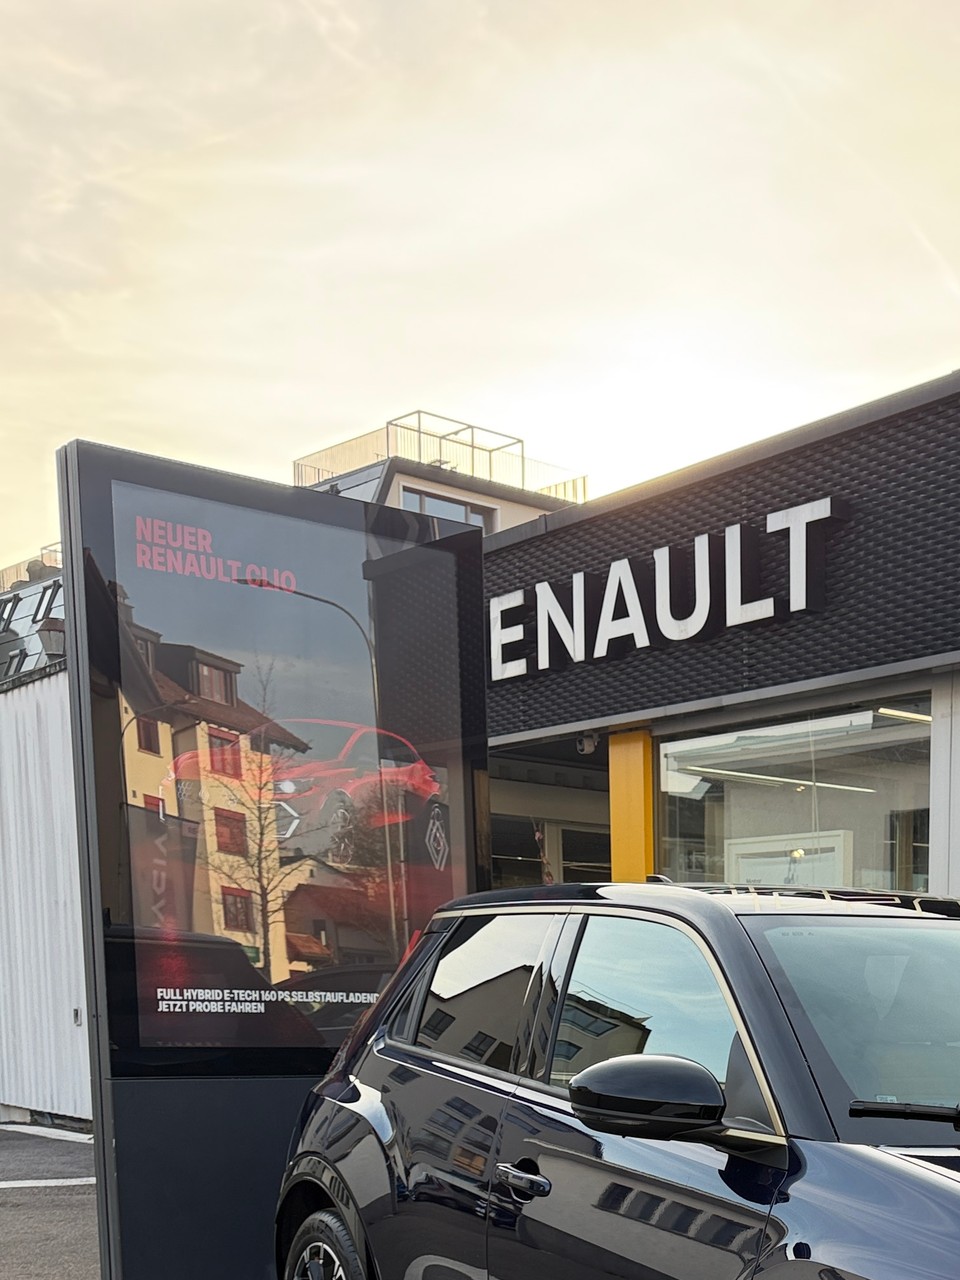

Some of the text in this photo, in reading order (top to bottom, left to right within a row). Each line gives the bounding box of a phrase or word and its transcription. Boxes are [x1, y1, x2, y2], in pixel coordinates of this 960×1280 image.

[135, 515, 213, 553] NEUER
[135, 543, 297, 594] RENAULT CLIO
[156, 988, 183, 1001] FULL
[183, 989, 223, 1001] HYBRID
[223, 989, 260, 1002] E-TECH
[260, 990, 277, 1002] 160
[277, 991, 291, 1002] PS
[157, 1001, 265, 1014] JETZT PROBE FAHREN
